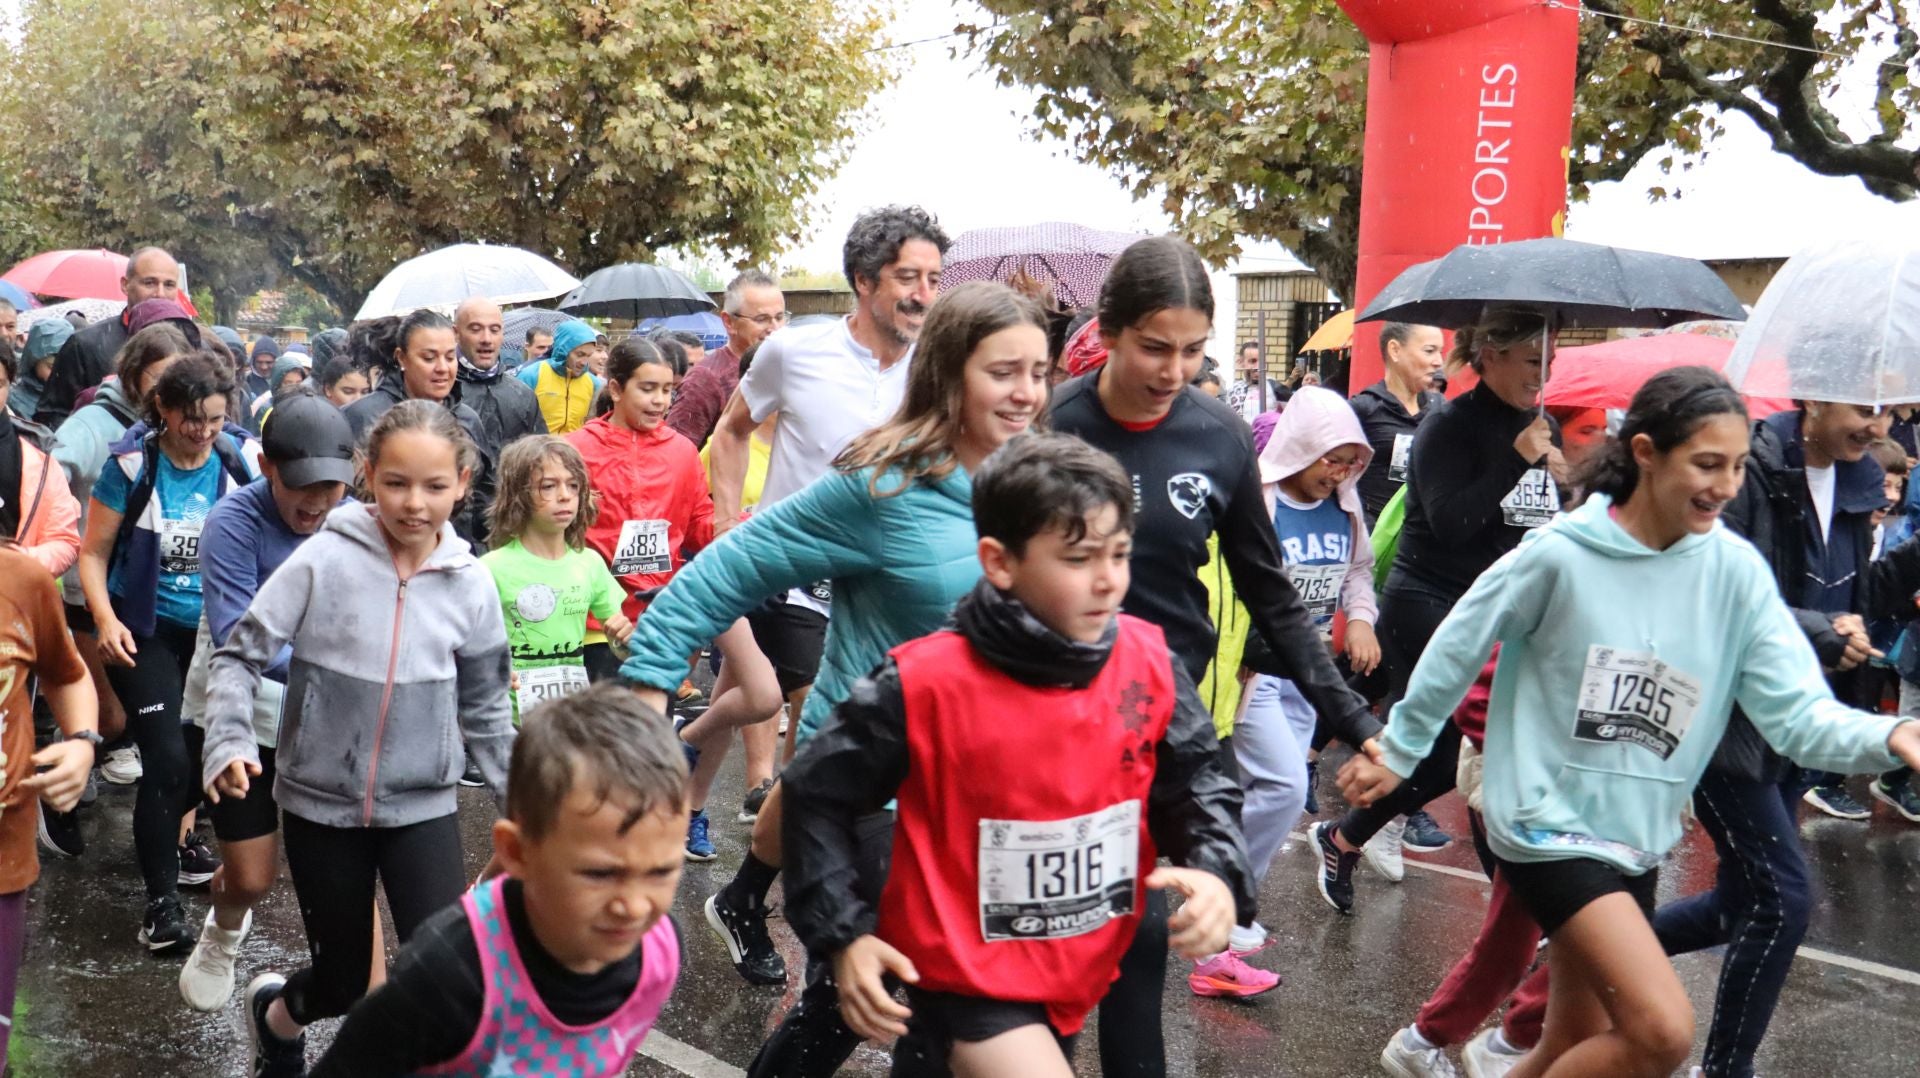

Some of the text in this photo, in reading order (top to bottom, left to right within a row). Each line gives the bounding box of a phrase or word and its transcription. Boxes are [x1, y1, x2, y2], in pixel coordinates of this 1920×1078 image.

[138, 703, 165, 715] NIKE
[1609, 673, 1676, 728] 1295
[1025, 842, 1104, 900] 1316
